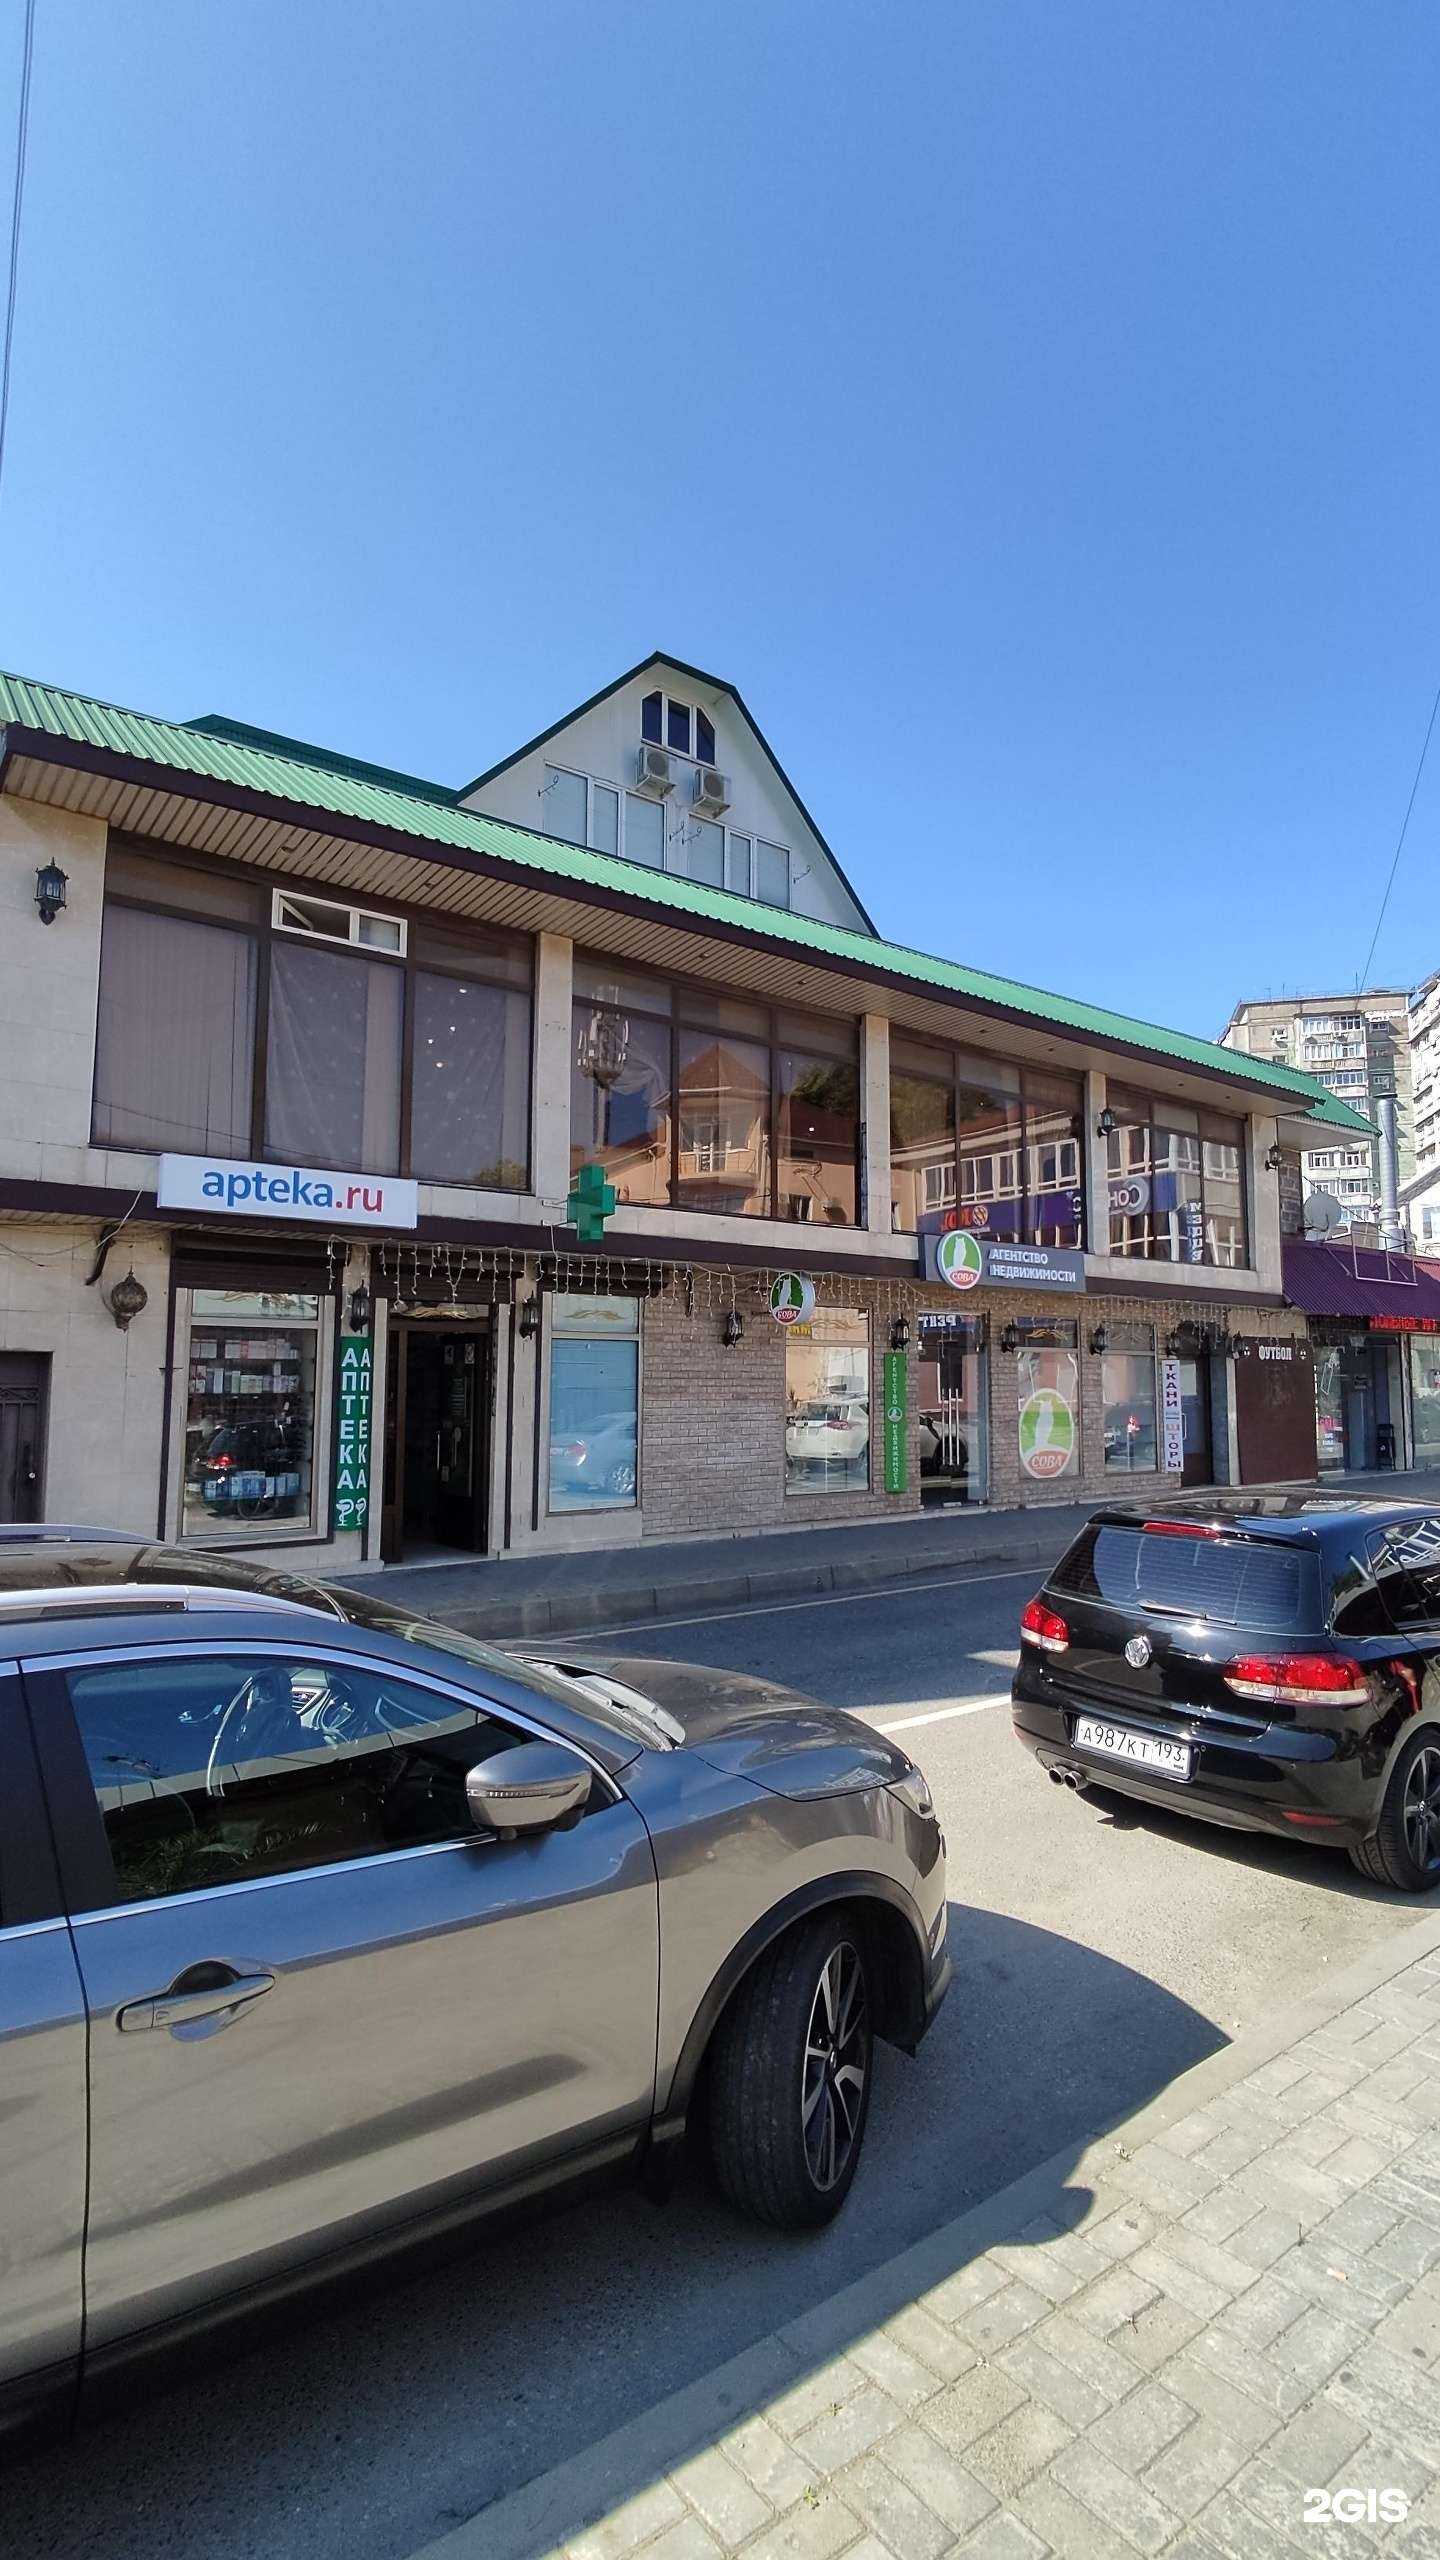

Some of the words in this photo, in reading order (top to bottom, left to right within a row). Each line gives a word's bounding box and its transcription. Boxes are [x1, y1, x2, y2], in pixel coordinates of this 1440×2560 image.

[202, 1171, 382, 1212] apteka.ru
[988, 1249, 1049, 1265] АГЕНТСТВО
[952, 1270, 975, 1282] СОВА
[989, 1265, 1077, 1283] НЕДВИЖИМОСТИ
[1258, 1345, 1293, 1361] ФУТБОЛ
[1165, 1363, 1178, 1407] ТКАНИ
[337, 1348, 358, 1489] АПТЕКА
[356, 1348, 371, 1489] АПТЕКА
[1165, 1423, 1182, 1468] ШТОРЫ
[1031, 1455, 1062, 1469] СОВА
[1154, 1742, 1182, 1762] 193
